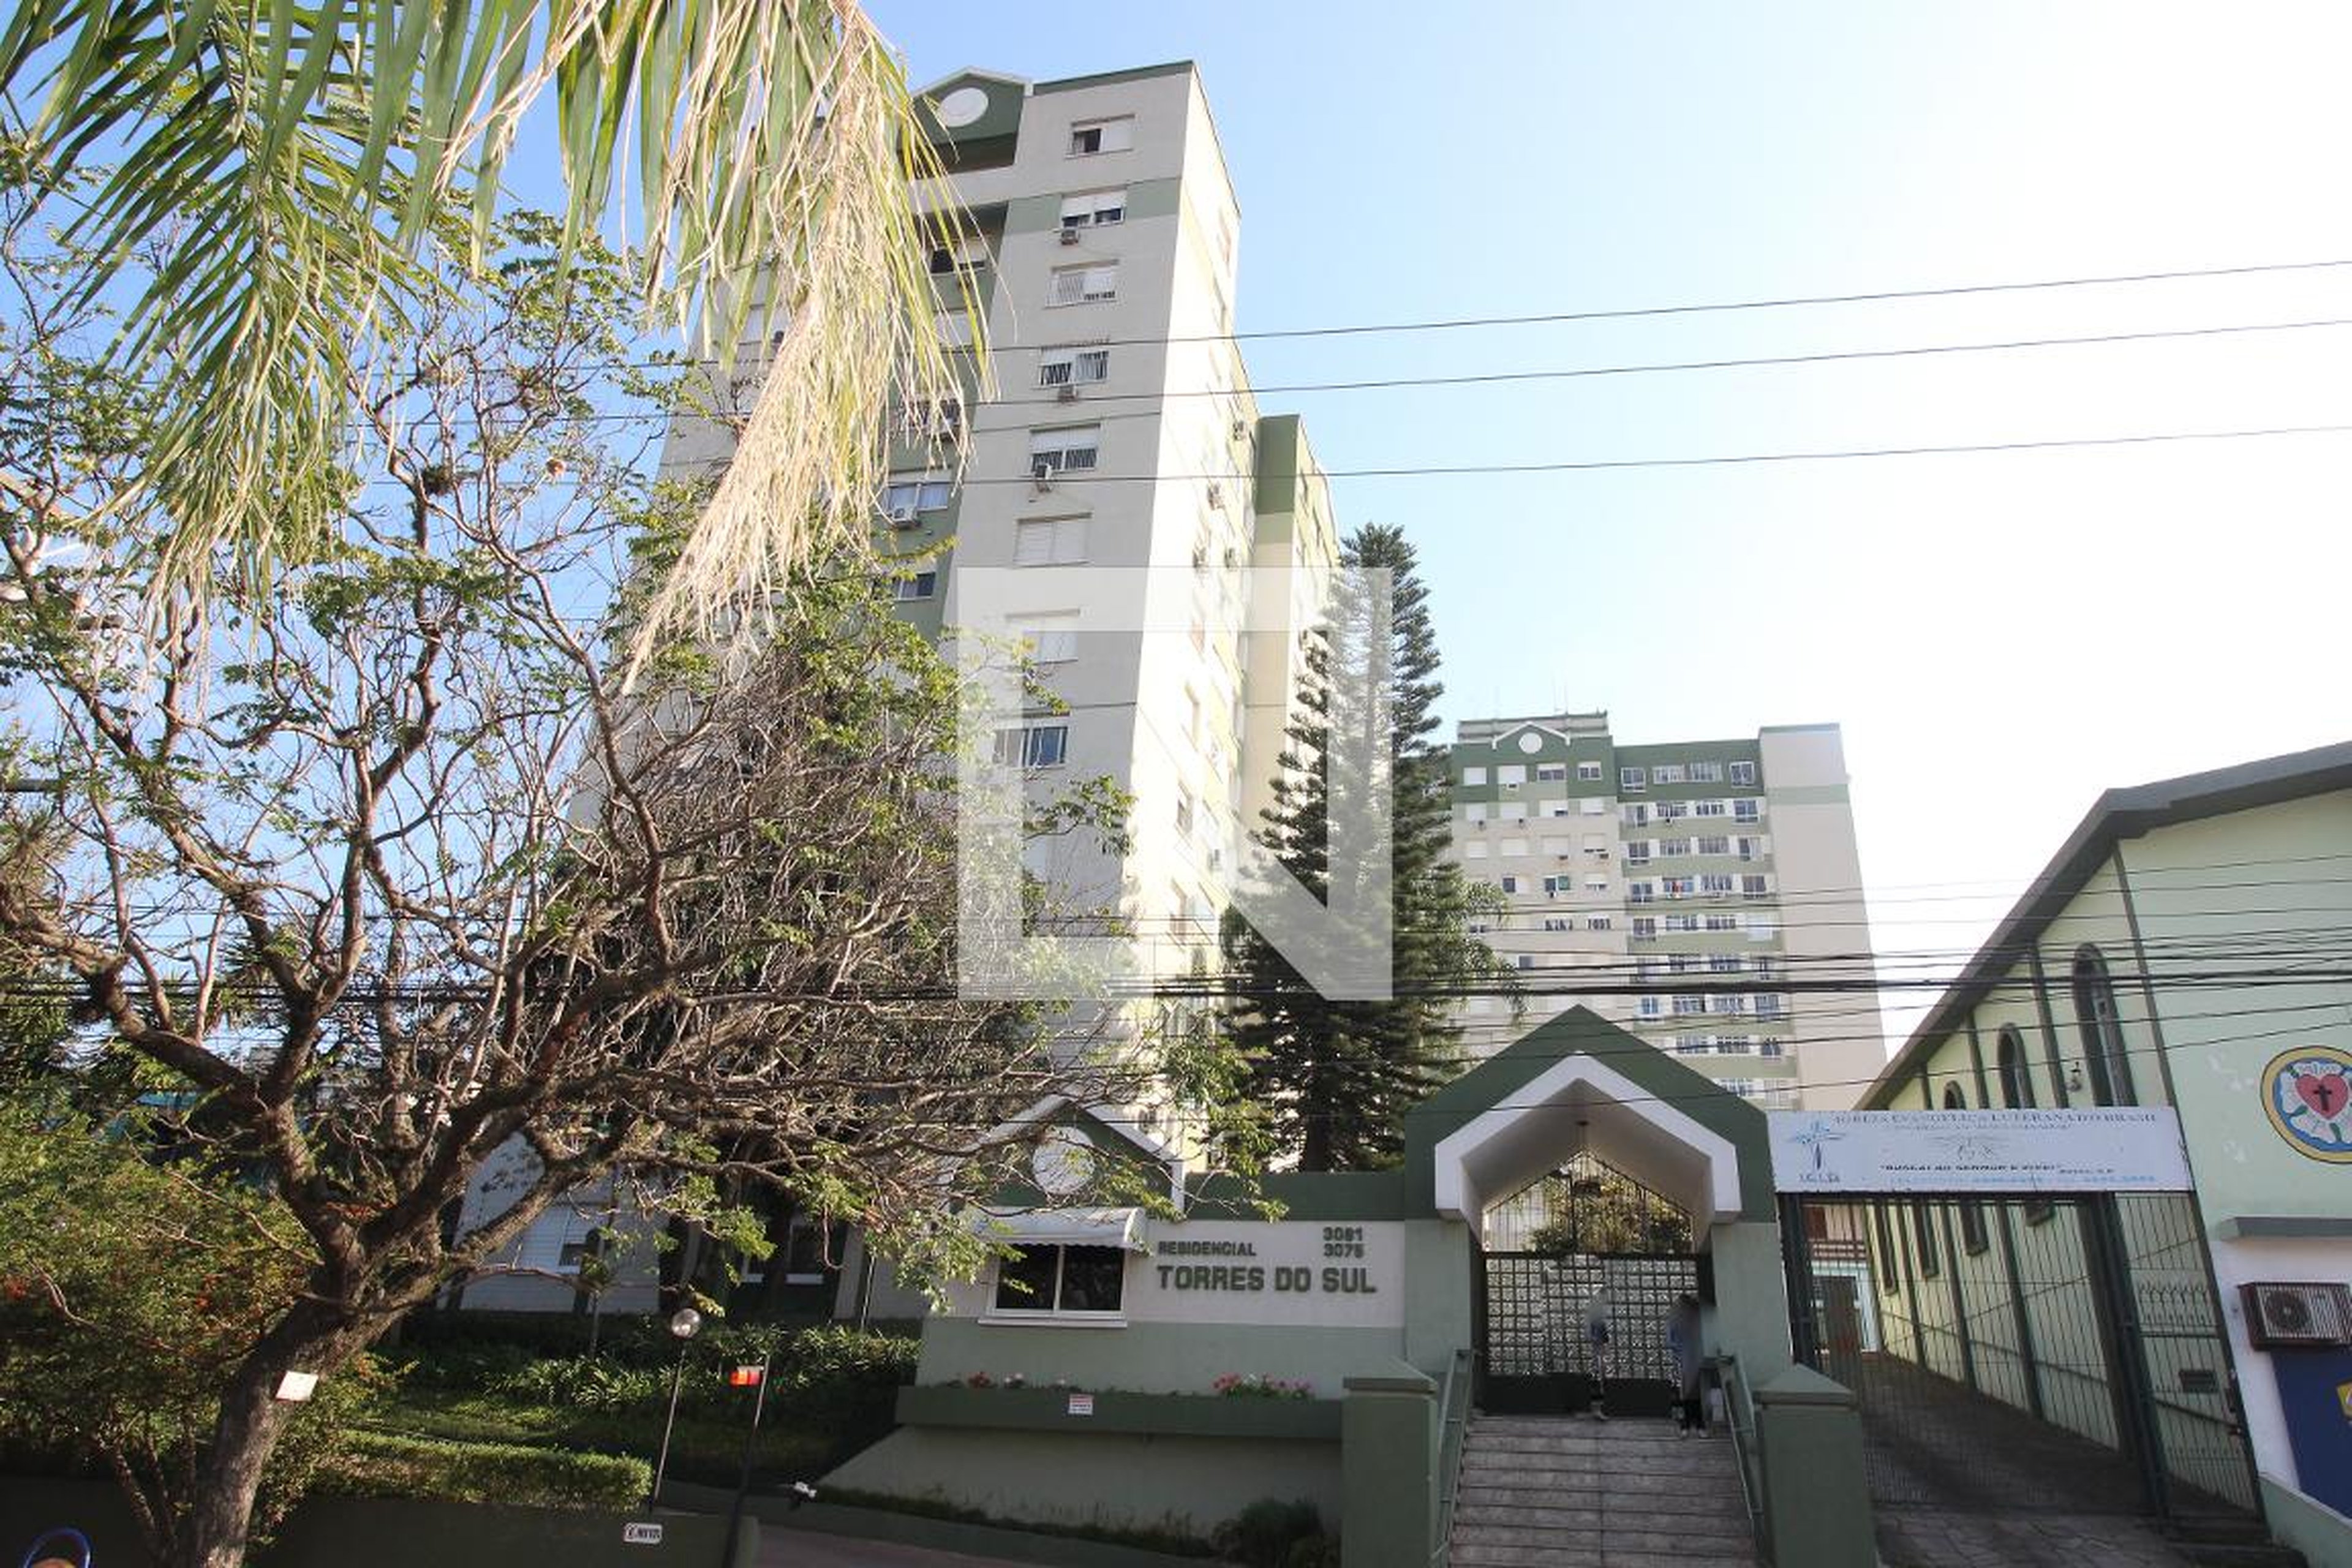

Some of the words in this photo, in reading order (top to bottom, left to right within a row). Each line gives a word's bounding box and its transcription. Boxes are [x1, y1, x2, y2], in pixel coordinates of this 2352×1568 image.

[1158, 1241, 1256, 1257] RESIDENCIAL
[1157, 1265, 1264, 1292] TORRES
[1274, 1267, 1311, 1292] DO
[1322, 1267, 1377, 1294] SUL
